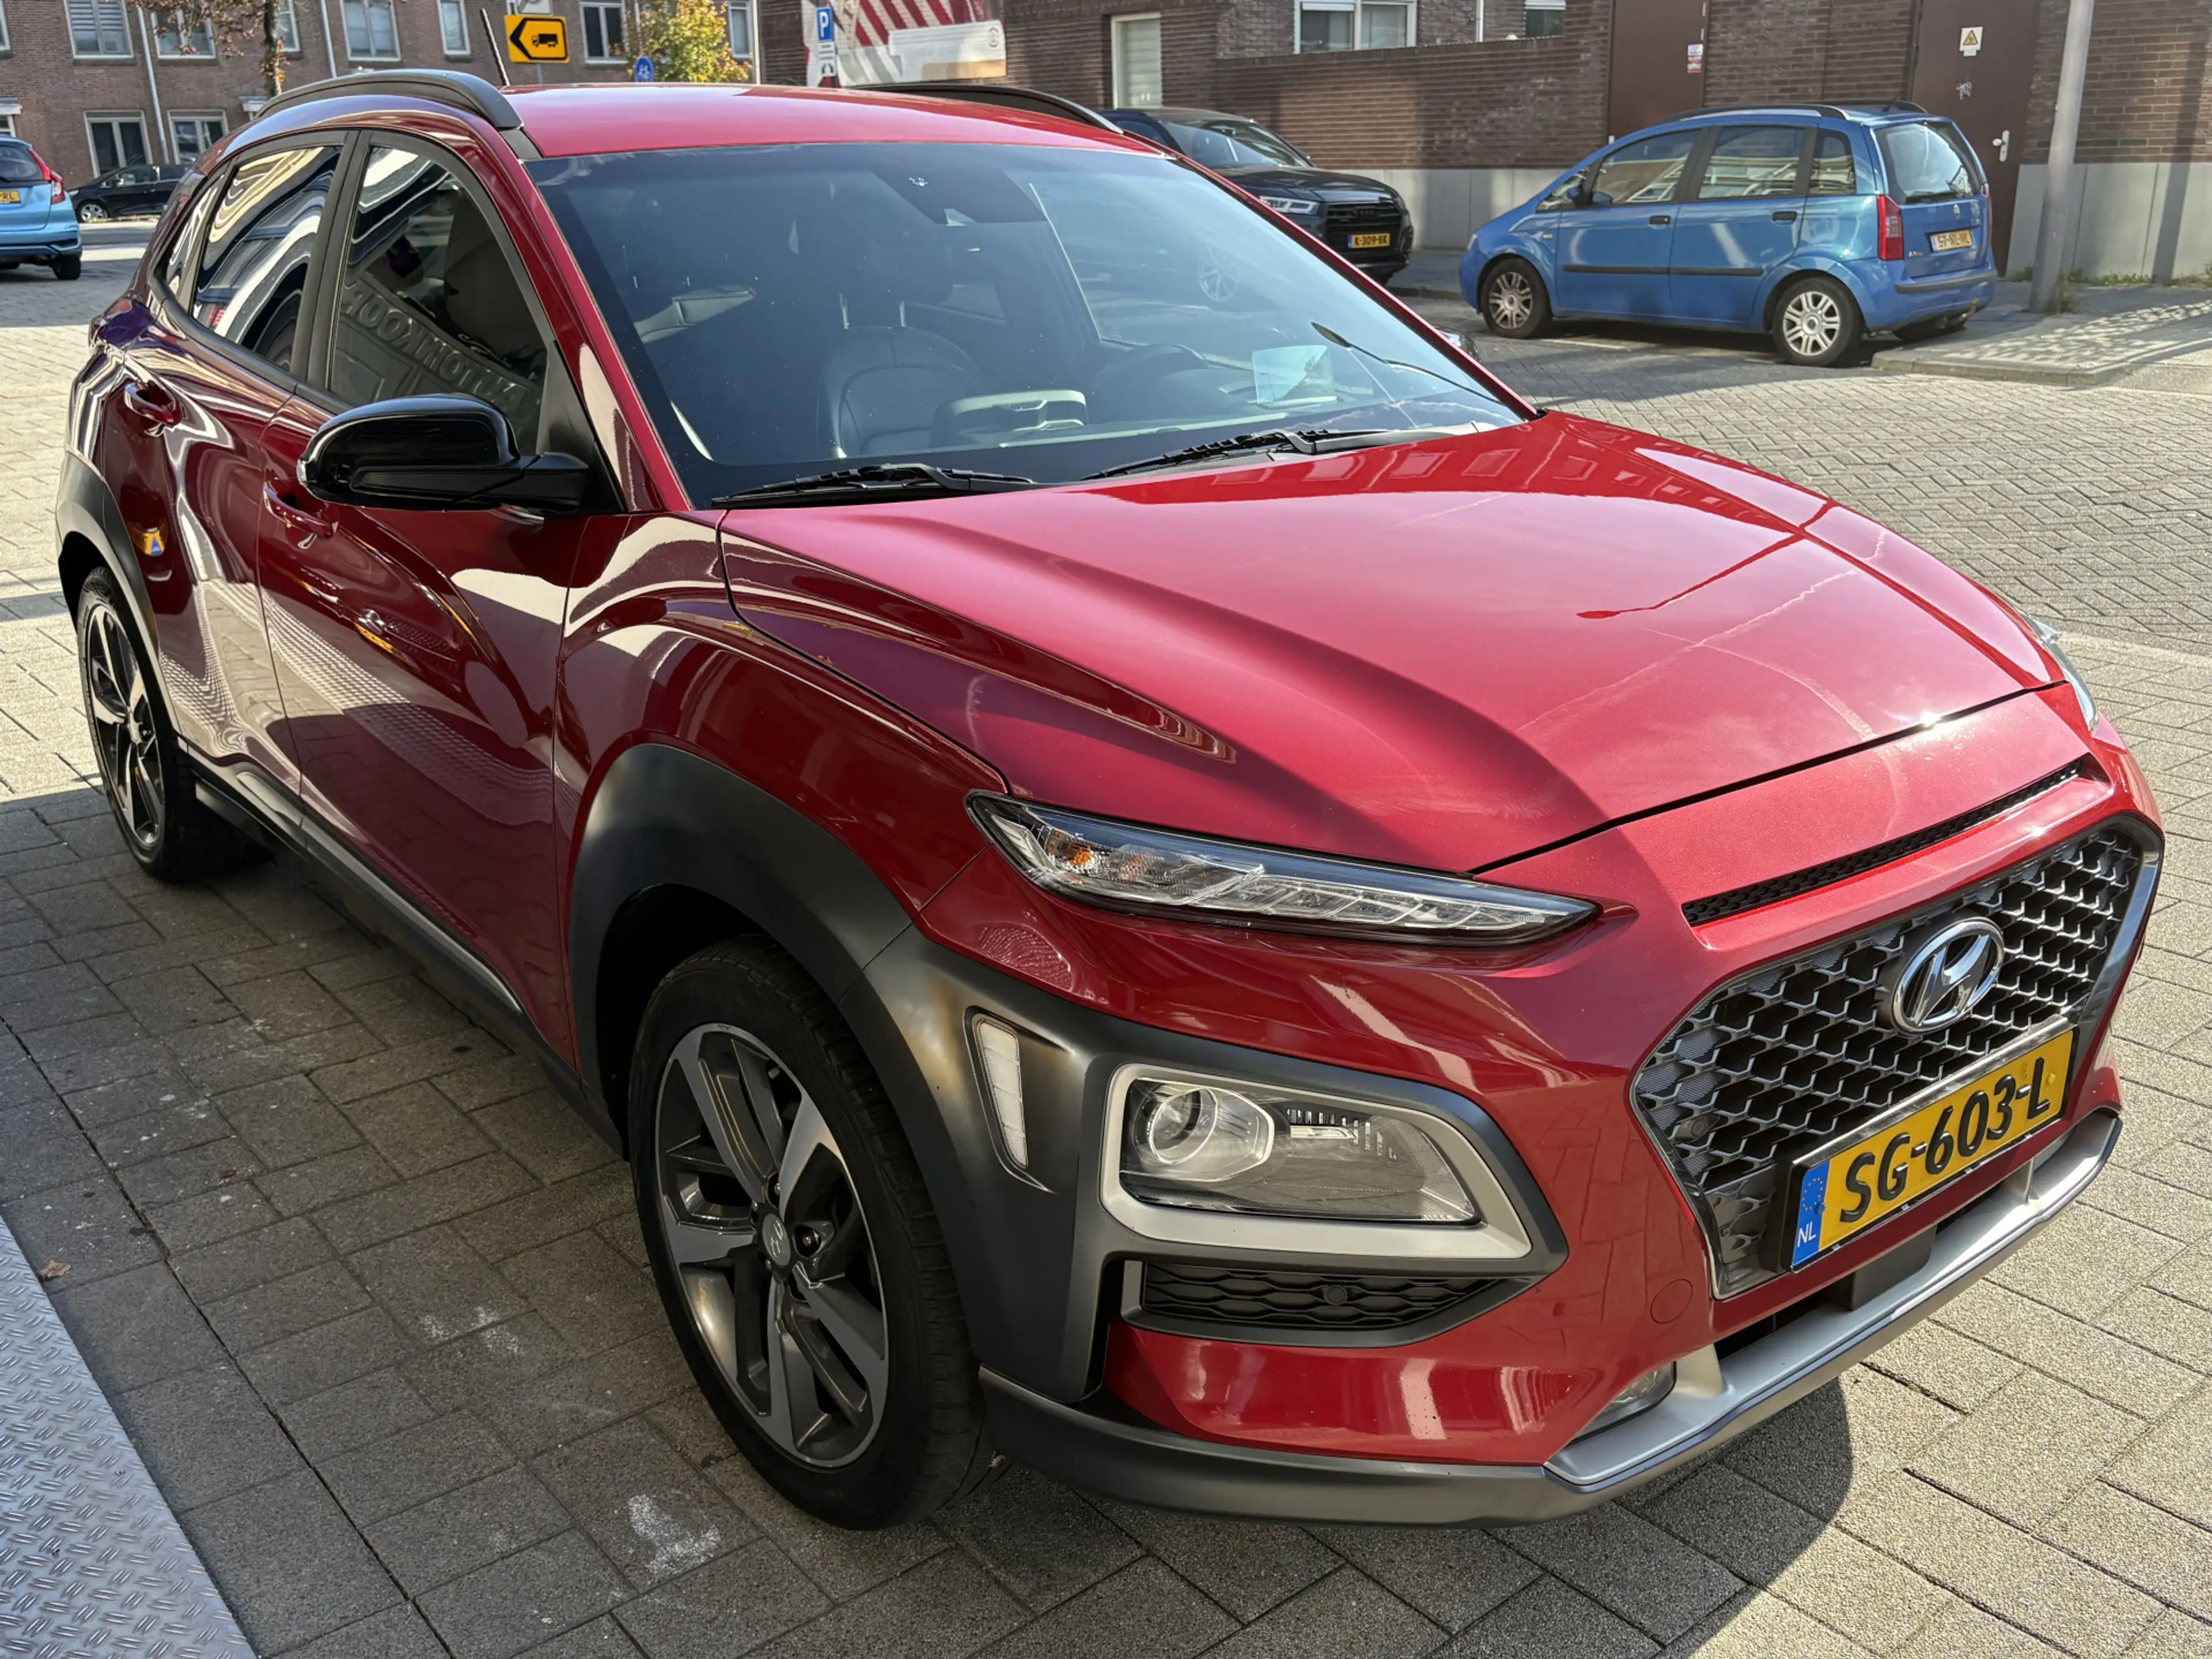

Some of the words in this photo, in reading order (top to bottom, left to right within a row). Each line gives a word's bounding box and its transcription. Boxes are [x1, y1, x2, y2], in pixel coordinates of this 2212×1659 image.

[819, 12, 829, 37] P
[1840, 1057, 2050, 1222] SG-603-L
[1797, 1221, 1817, 1248] NL
